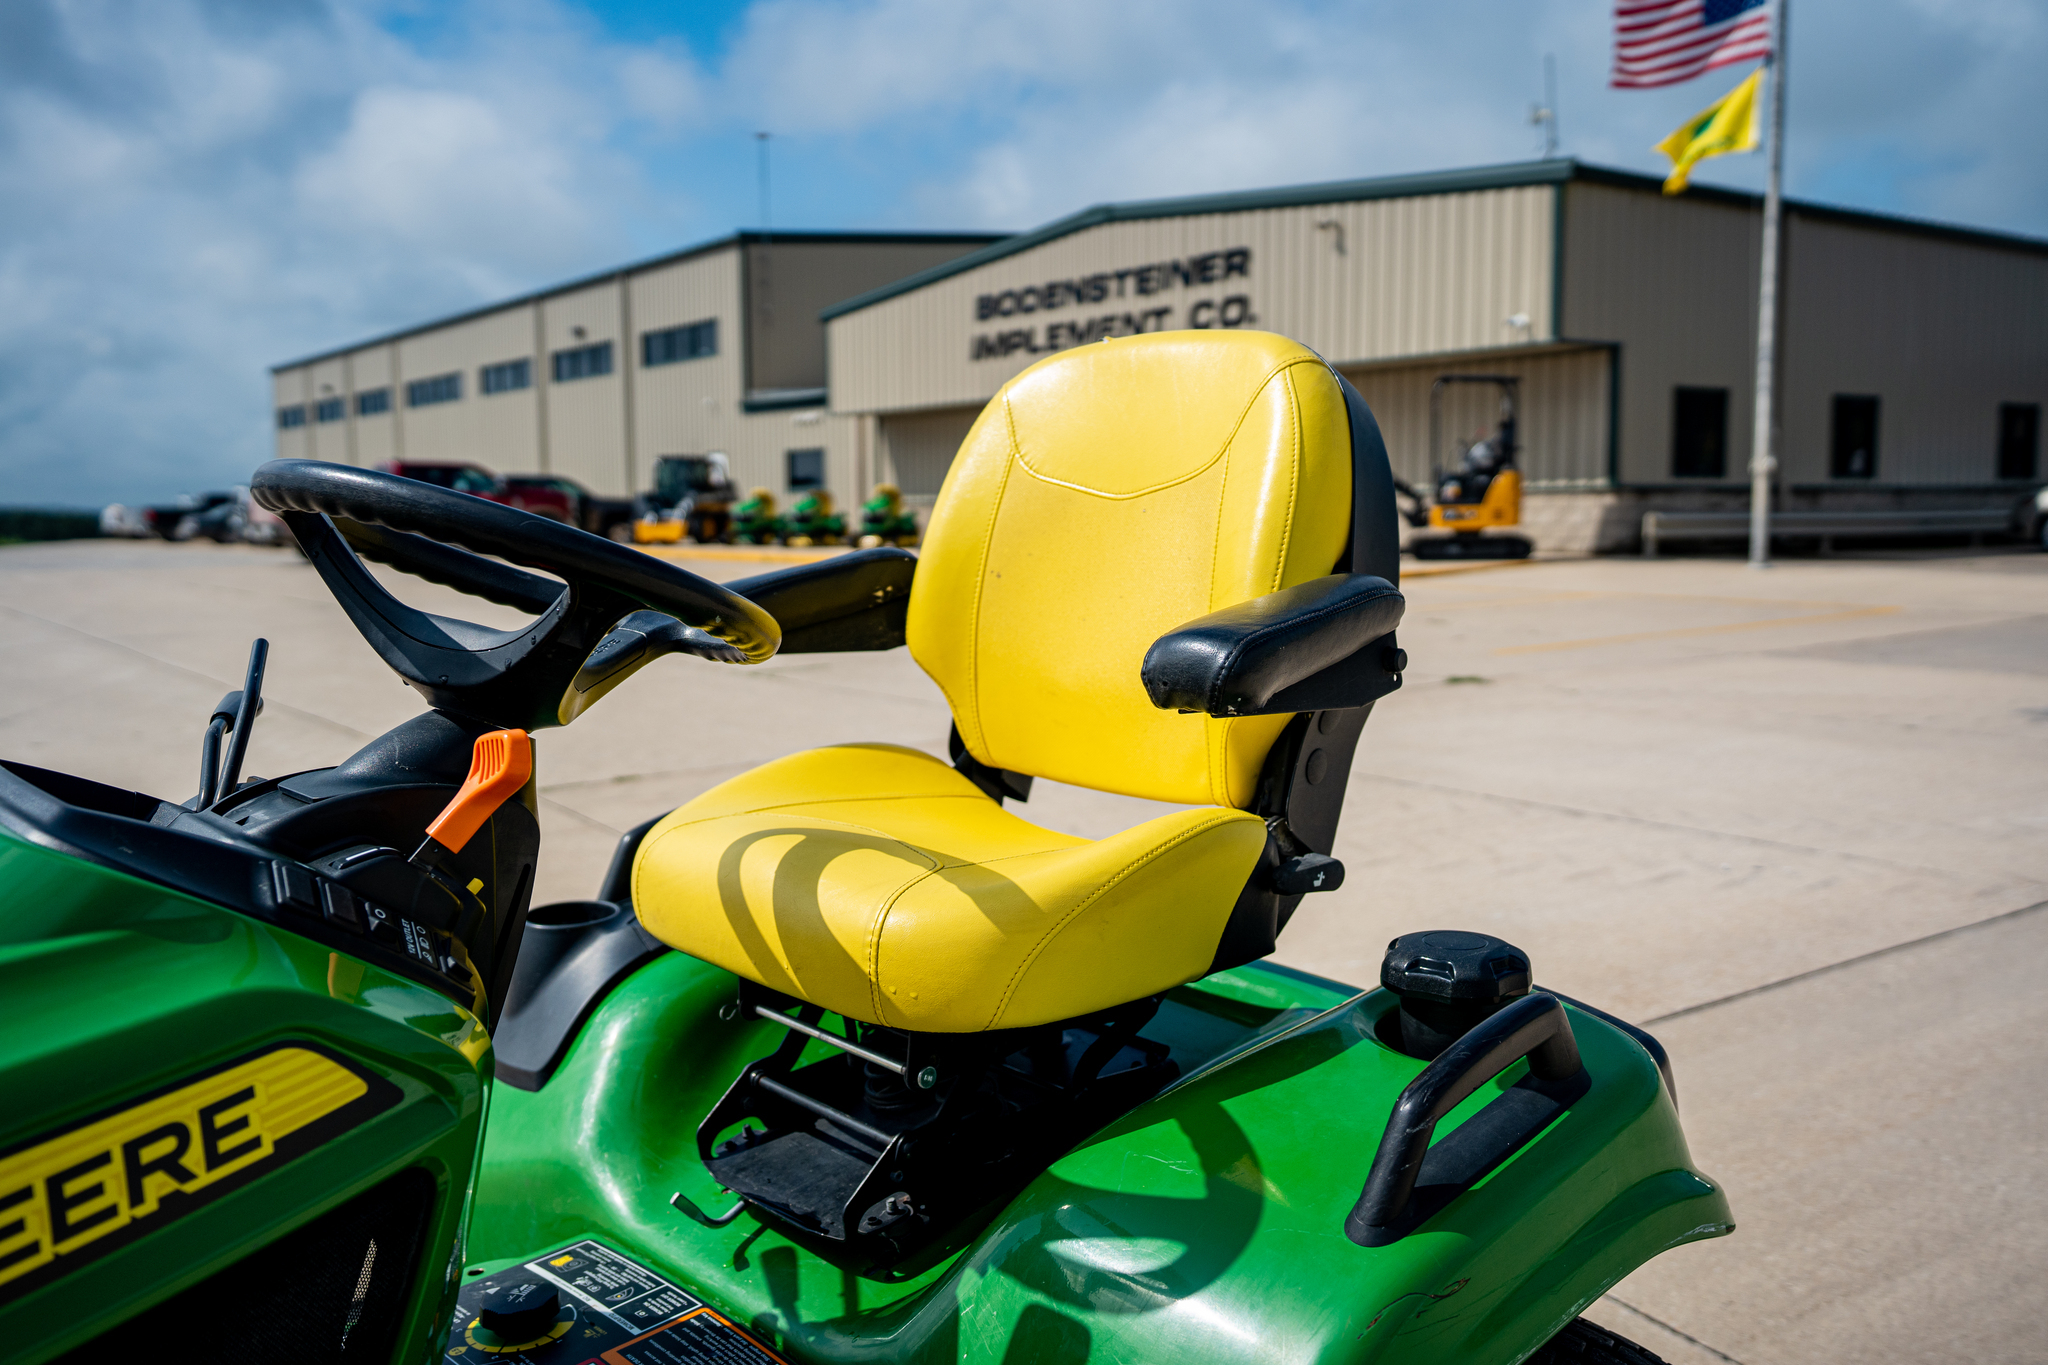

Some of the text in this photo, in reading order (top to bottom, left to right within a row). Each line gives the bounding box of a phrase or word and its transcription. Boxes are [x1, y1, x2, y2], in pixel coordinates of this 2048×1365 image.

[976, 247, 1252, 321] BODENSTEINER
[970, 294, 1257, 362] IMPLEMENT CO.
[401, 918, 413, 942] OUTLET
[608, 1313, 635, 1330] MOWER/PTO
